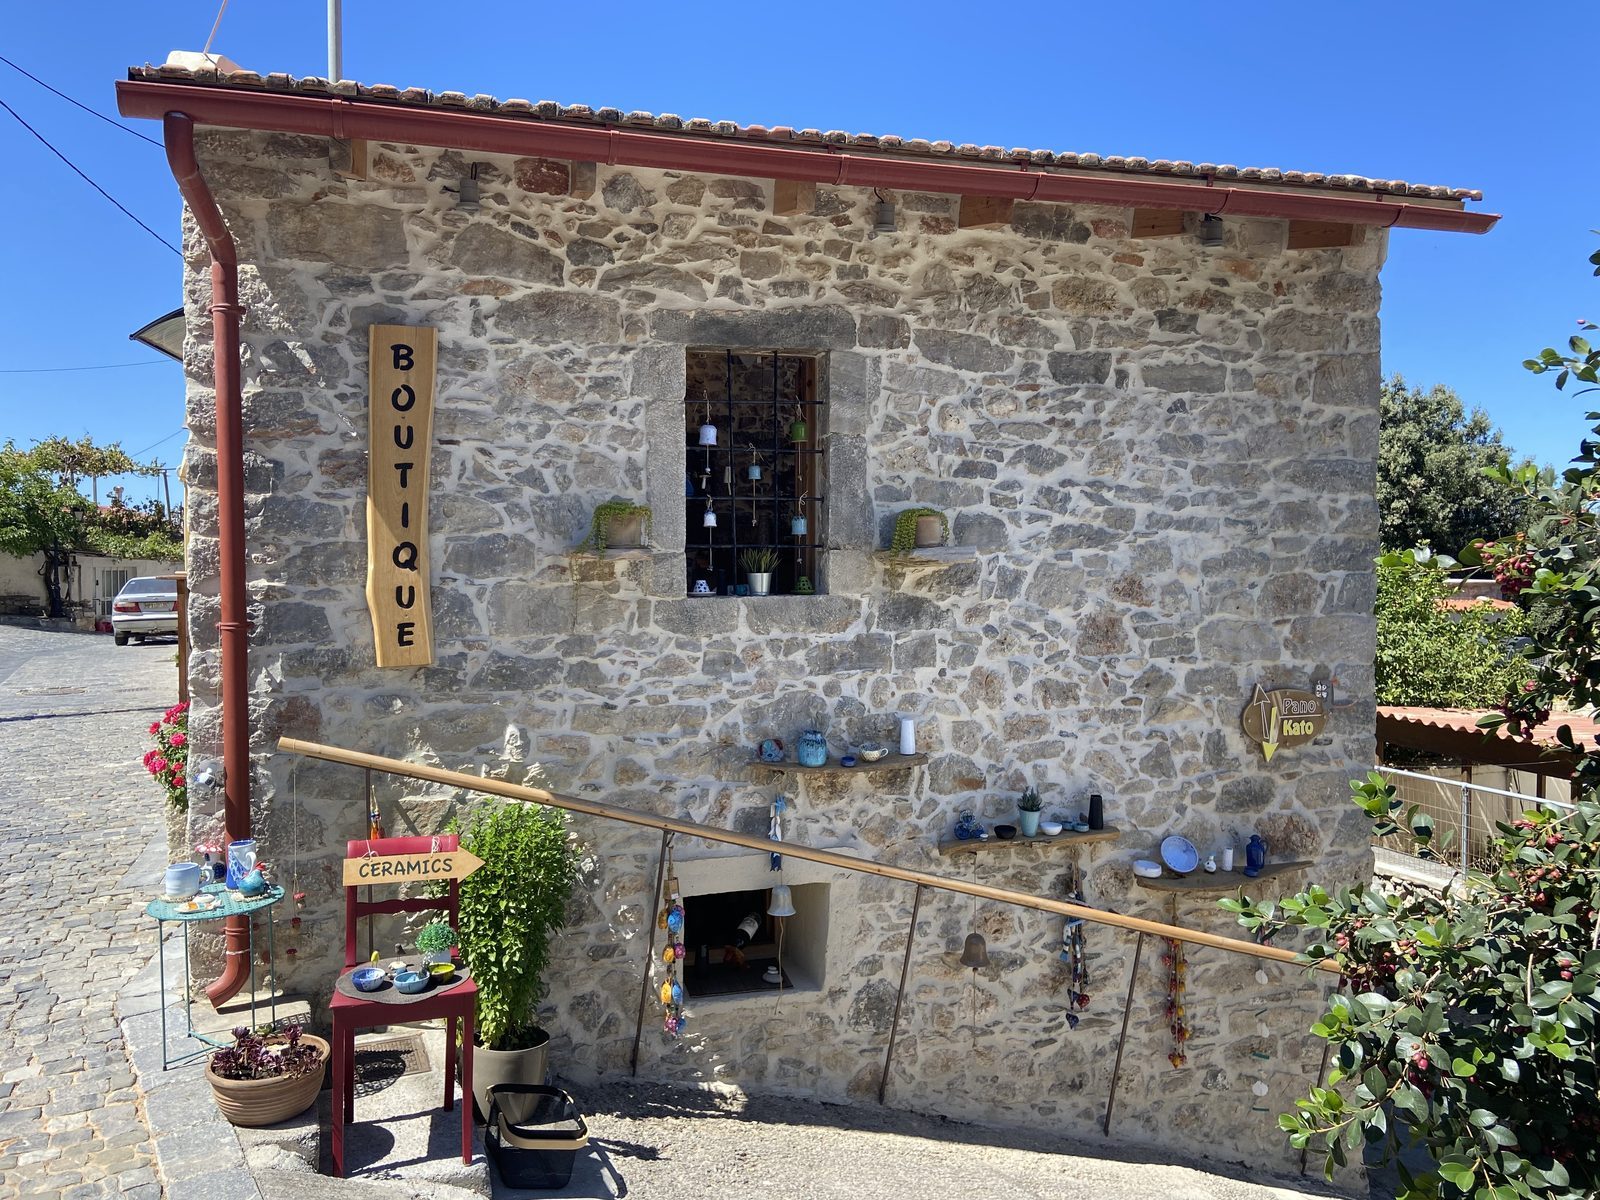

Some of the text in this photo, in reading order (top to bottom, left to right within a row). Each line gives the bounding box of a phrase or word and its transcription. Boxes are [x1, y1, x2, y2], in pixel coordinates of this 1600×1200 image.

[390, 343, 418, 647] BOUTIQUE
[1282, 698, 1317, 714] Pano
[1282, 719, 1314, 736] Kato
[358, 858, 453, 878] CERAMICS
